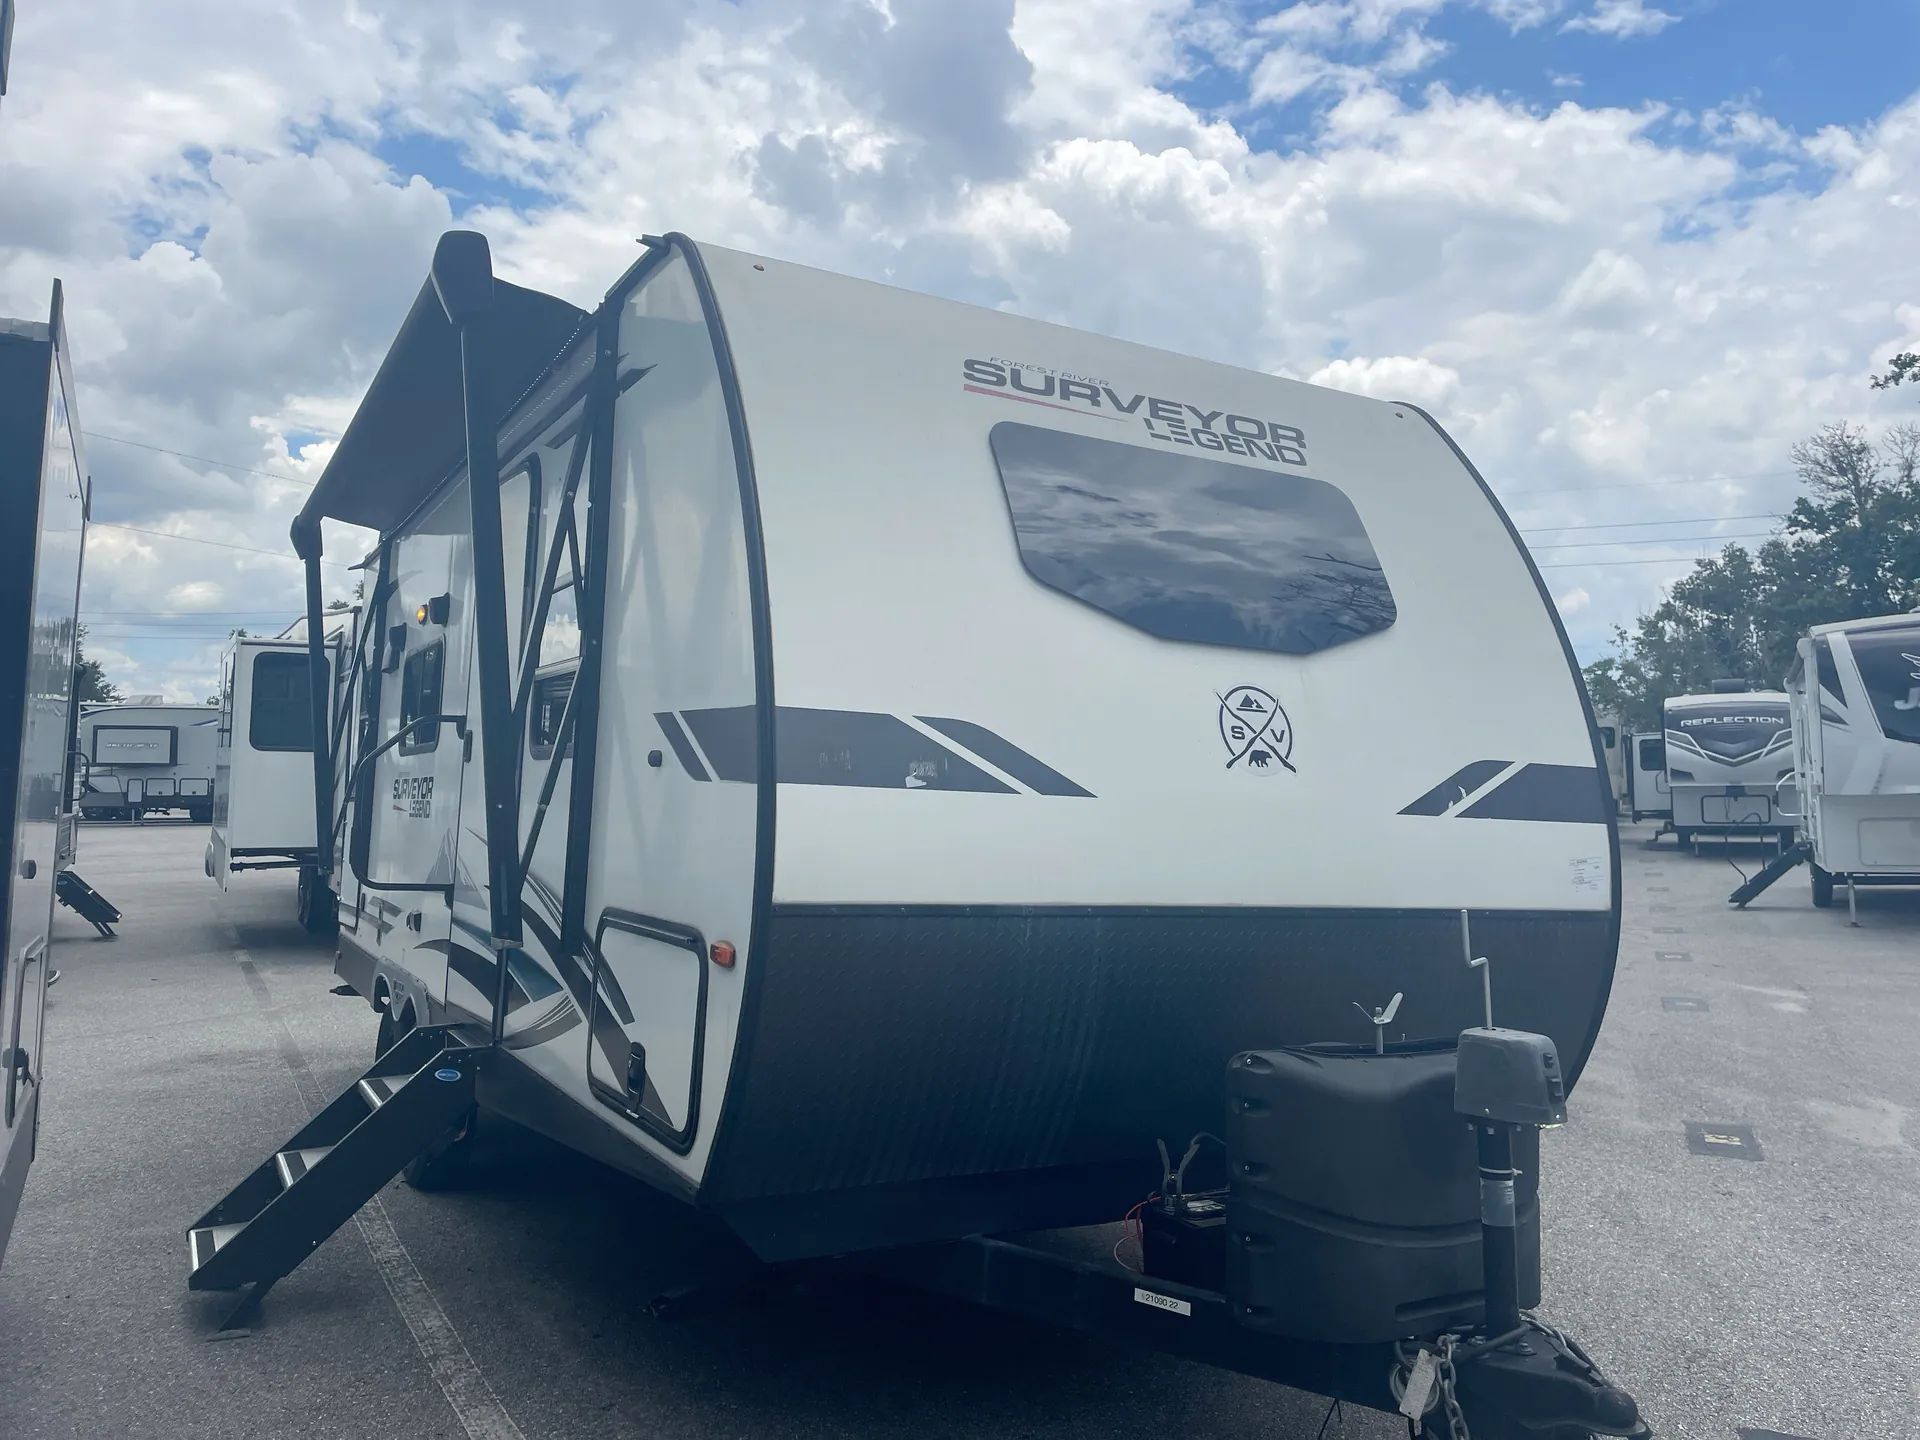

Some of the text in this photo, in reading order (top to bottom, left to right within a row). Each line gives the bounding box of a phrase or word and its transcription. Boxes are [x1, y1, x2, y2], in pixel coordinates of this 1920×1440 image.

[990, 357, 1110, 387] FOREST RIVER
[963, 358, 1307, 449] SURVEYOR
[1143, 417, 1307, 467] LEGEND
[1680, 716, 1784, 728] REFLECTION
[392, 776, 434, 800] SURVEYOR
[1168, 1300, 1179, 1310] 22
